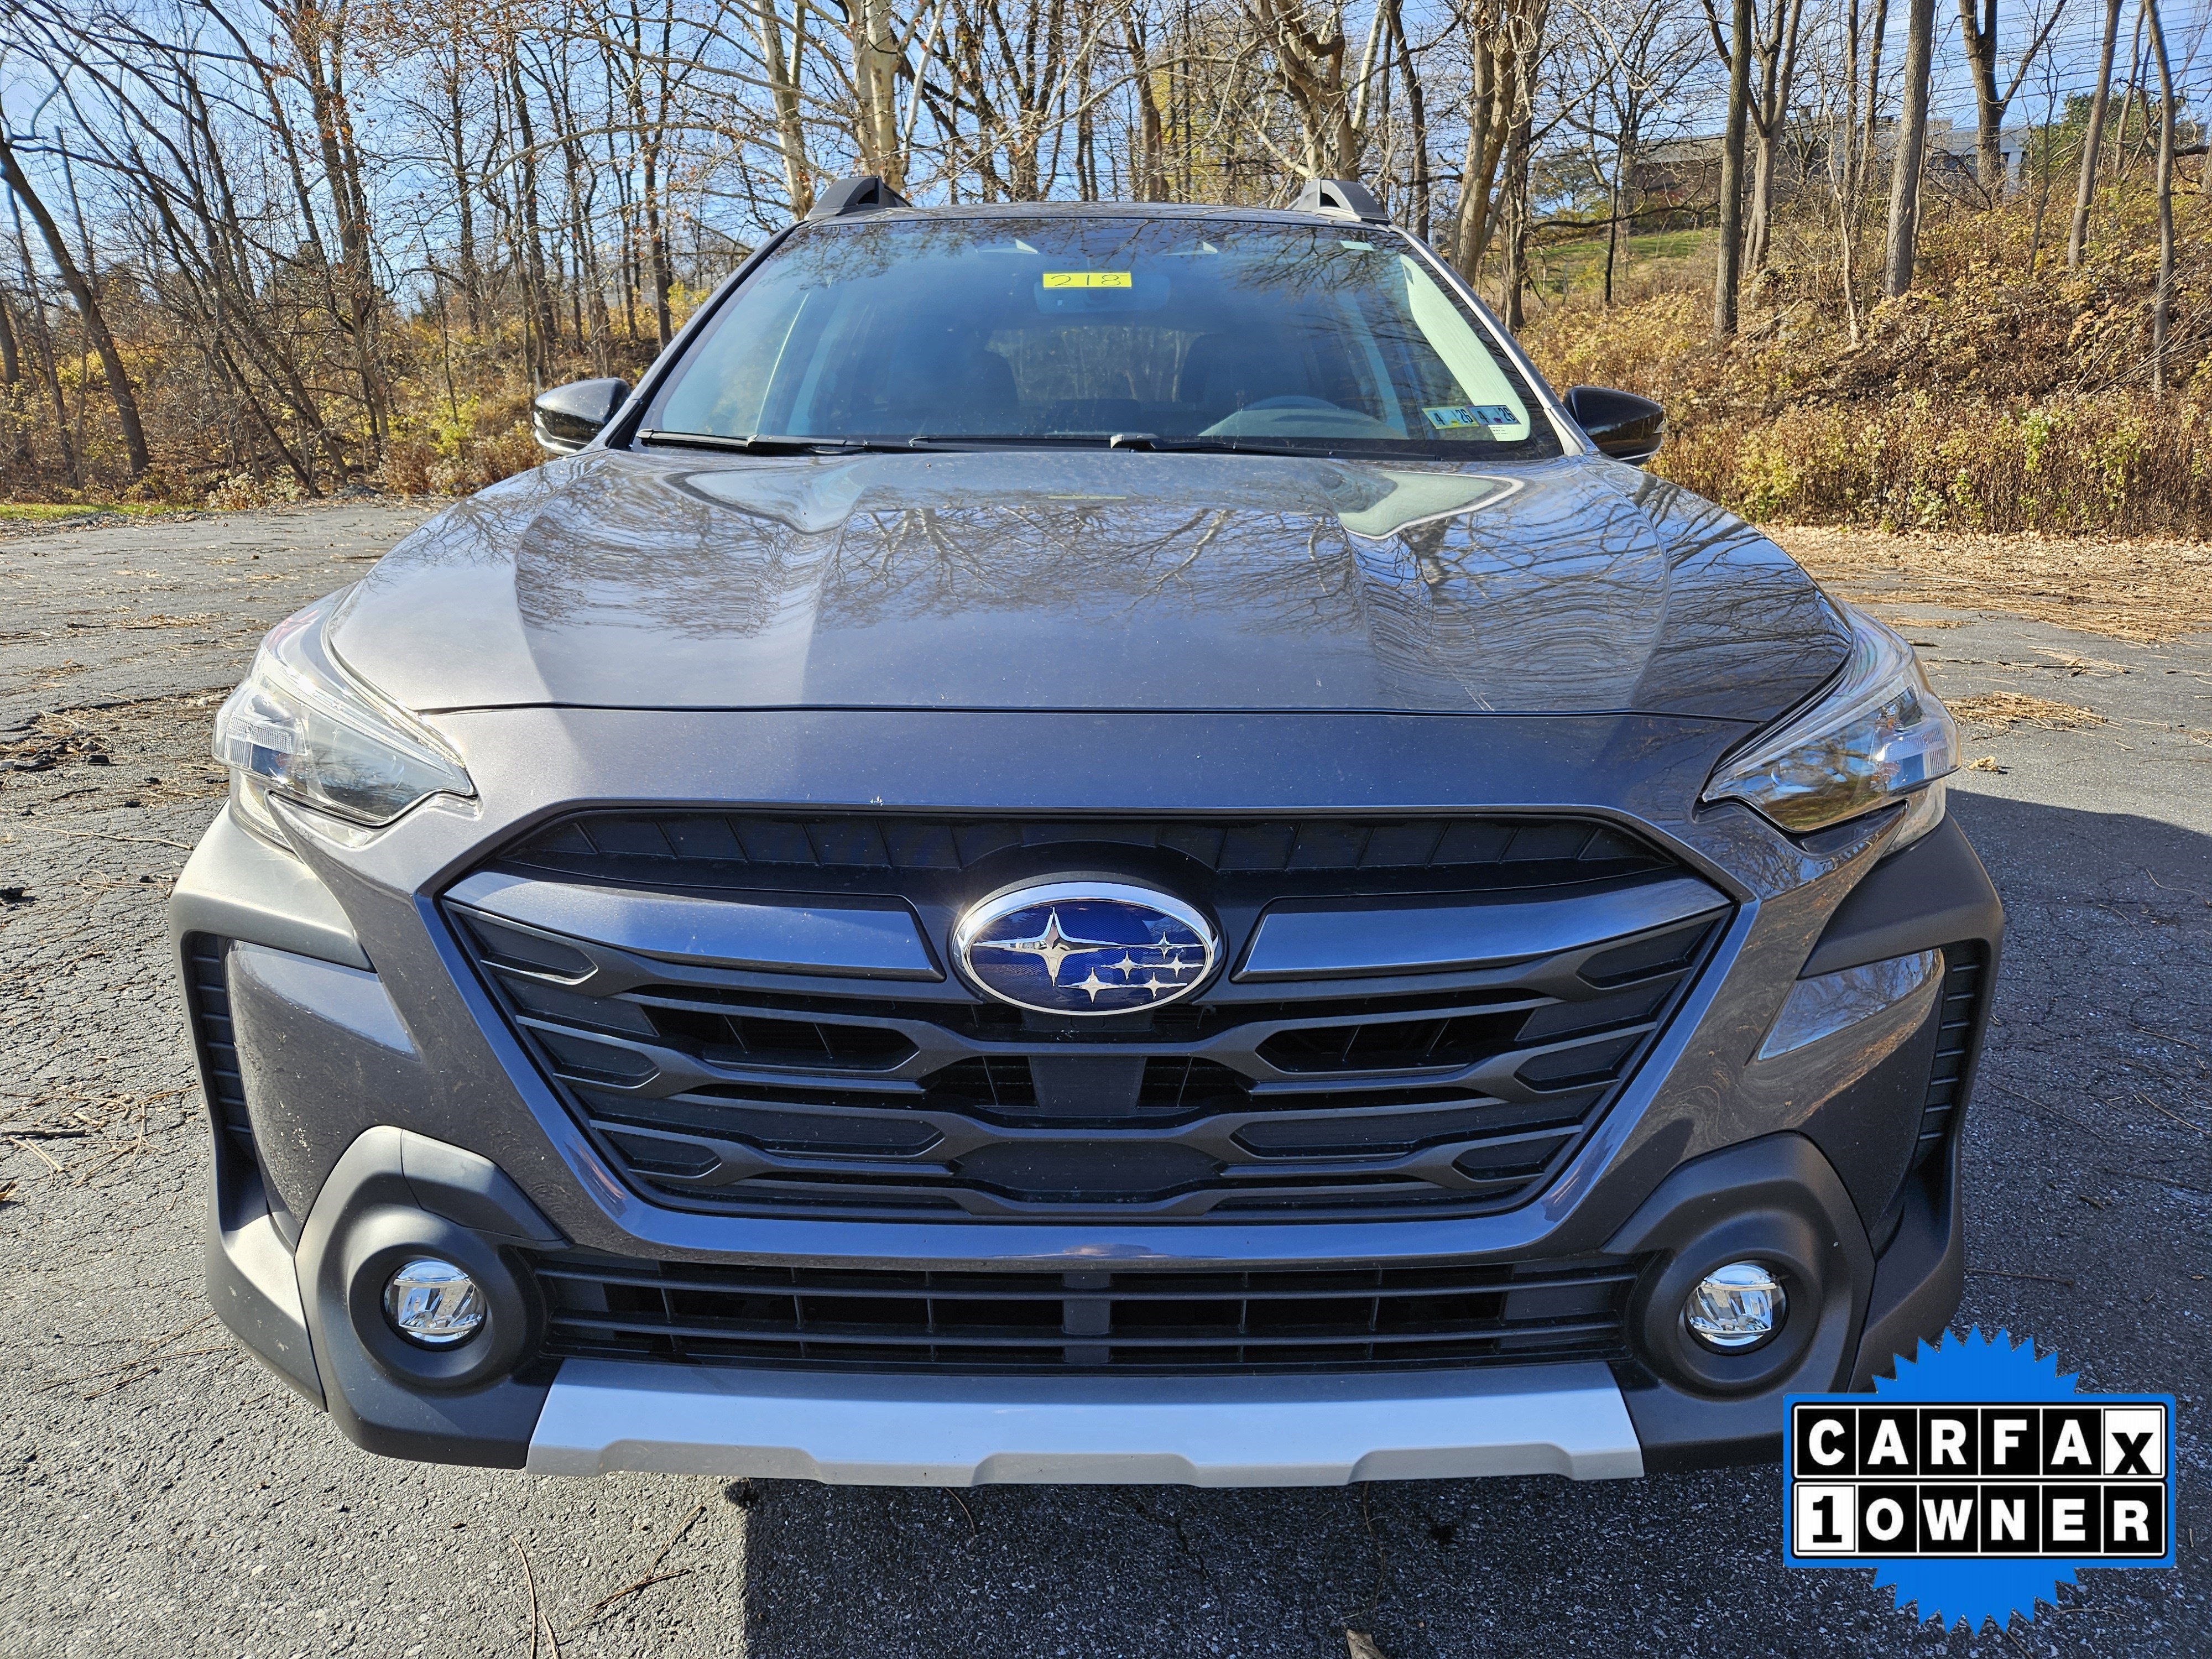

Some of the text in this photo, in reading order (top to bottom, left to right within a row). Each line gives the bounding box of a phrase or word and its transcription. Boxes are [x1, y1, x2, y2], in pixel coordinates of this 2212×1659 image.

[1051, 274, 1121, 286] 218
[1433, 409, 1473, 425] 4 26
[1477, 407, 1516, 423] 4 26
